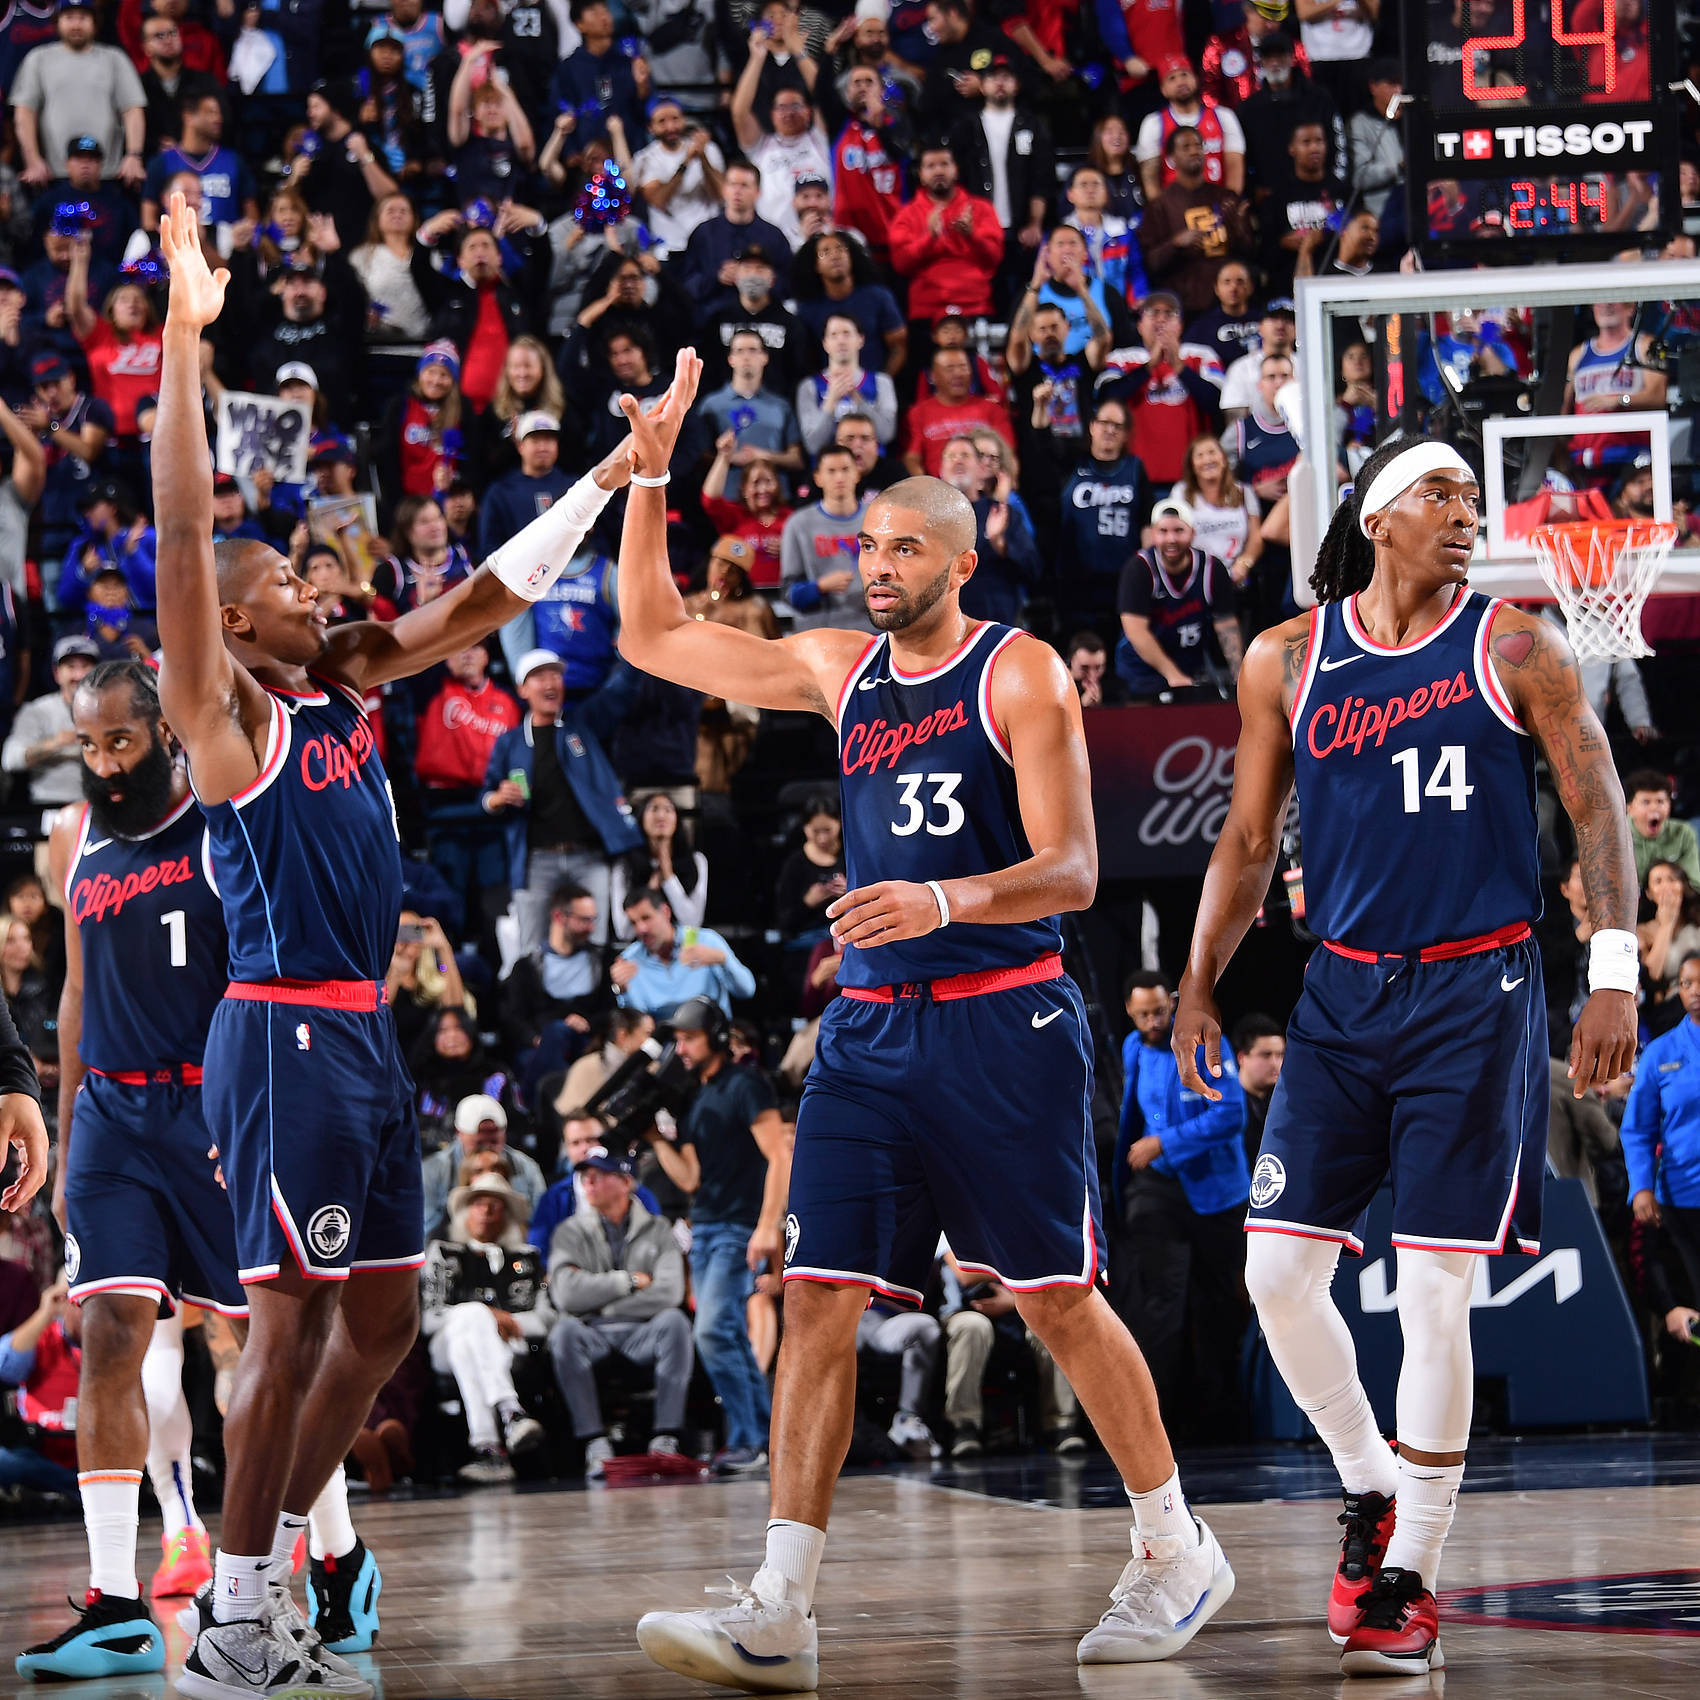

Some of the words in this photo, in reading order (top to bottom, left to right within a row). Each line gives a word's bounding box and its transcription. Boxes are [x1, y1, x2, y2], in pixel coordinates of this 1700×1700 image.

[512, 7, 542, 38] 23
[1461, 0, 1616, 100] 24
[1495, 120, 1653, 158] TISSOT
[1510, 181, 1607, 228] 2:44
[842, 700, 969, 776] Clippers
[1307, 670, 1474, 759] Clippers
[891, 773, 965, 836] 33
[1391, 745, 1475, 813] 14
[72, 854, 194, 926] Clippers
[160, 910, 187, 967] 1
